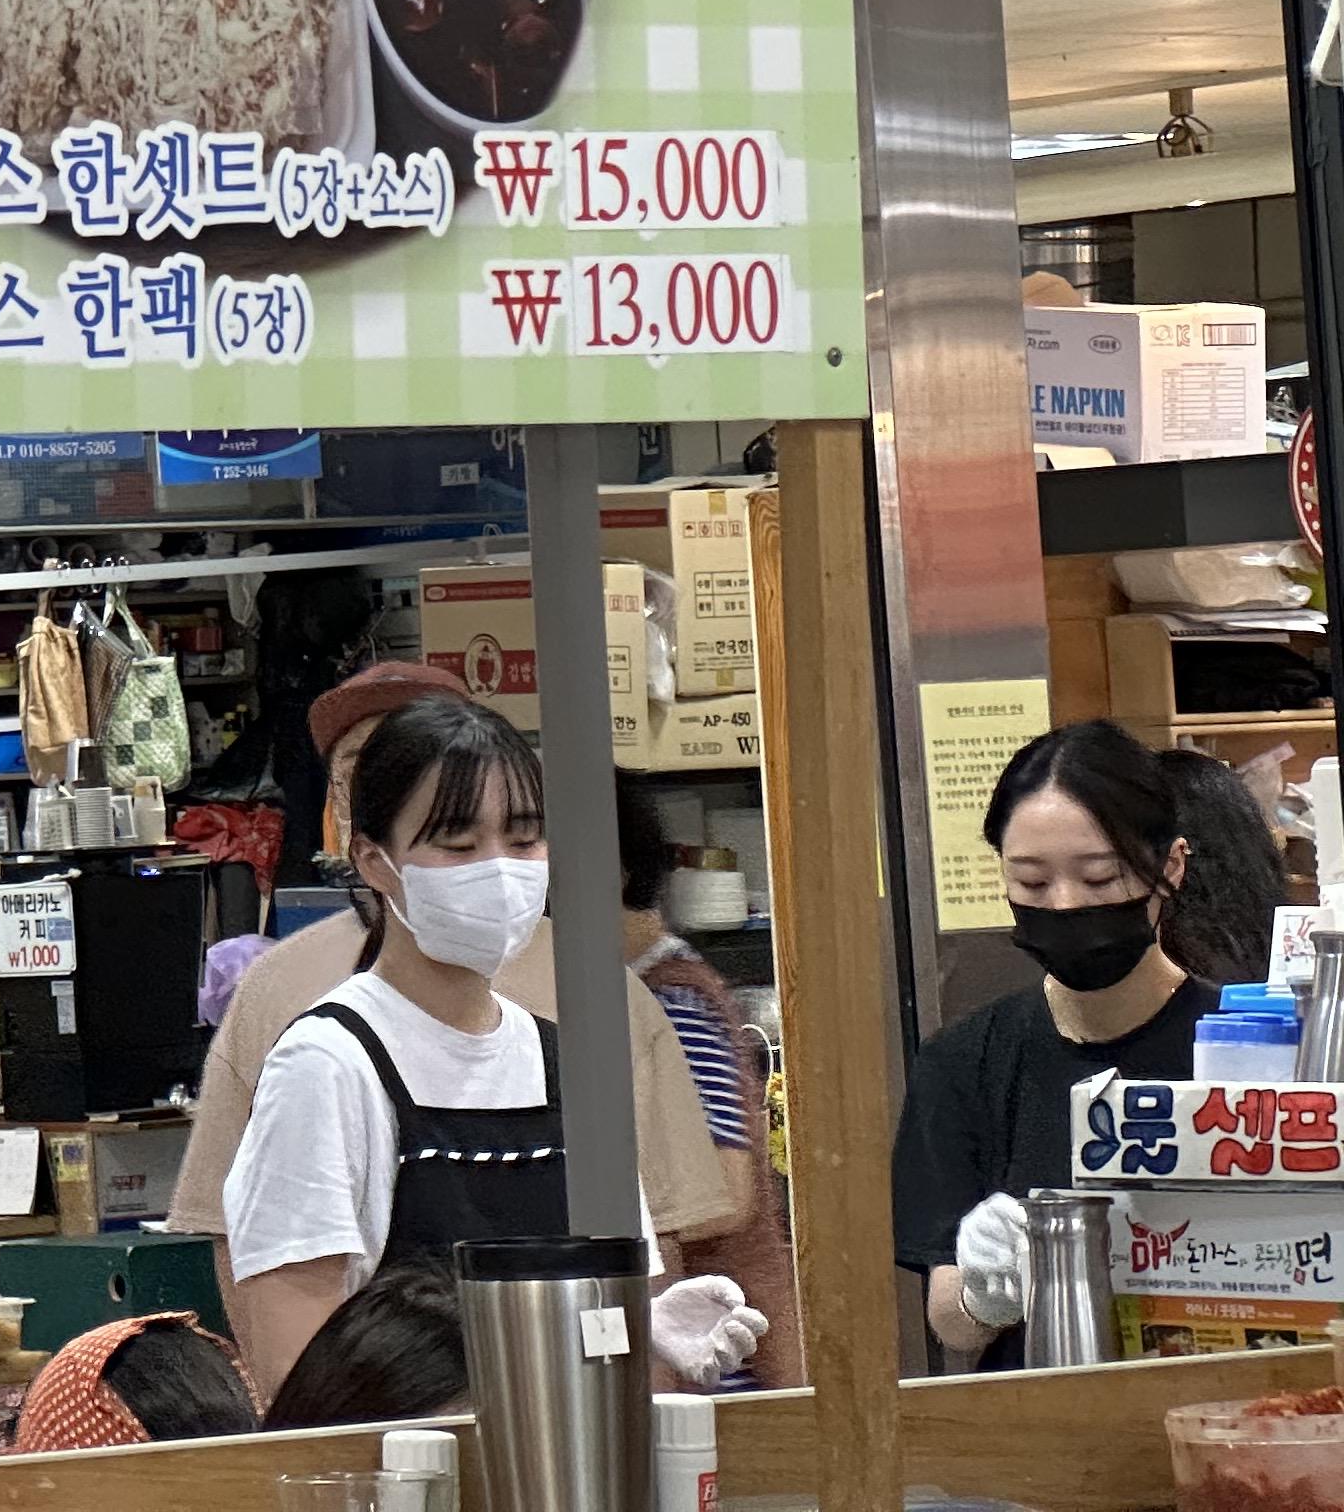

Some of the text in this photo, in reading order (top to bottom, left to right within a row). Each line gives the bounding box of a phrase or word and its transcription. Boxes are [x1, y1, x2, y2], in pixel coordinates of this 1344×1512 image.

[1051, 386, 1125, 419] NAPKIN
[1, 893, 62, 915] 아메리카노
[18, 918, 46, 940] 커피
[1120, 1084, 1341, 1177] 물 셀프
